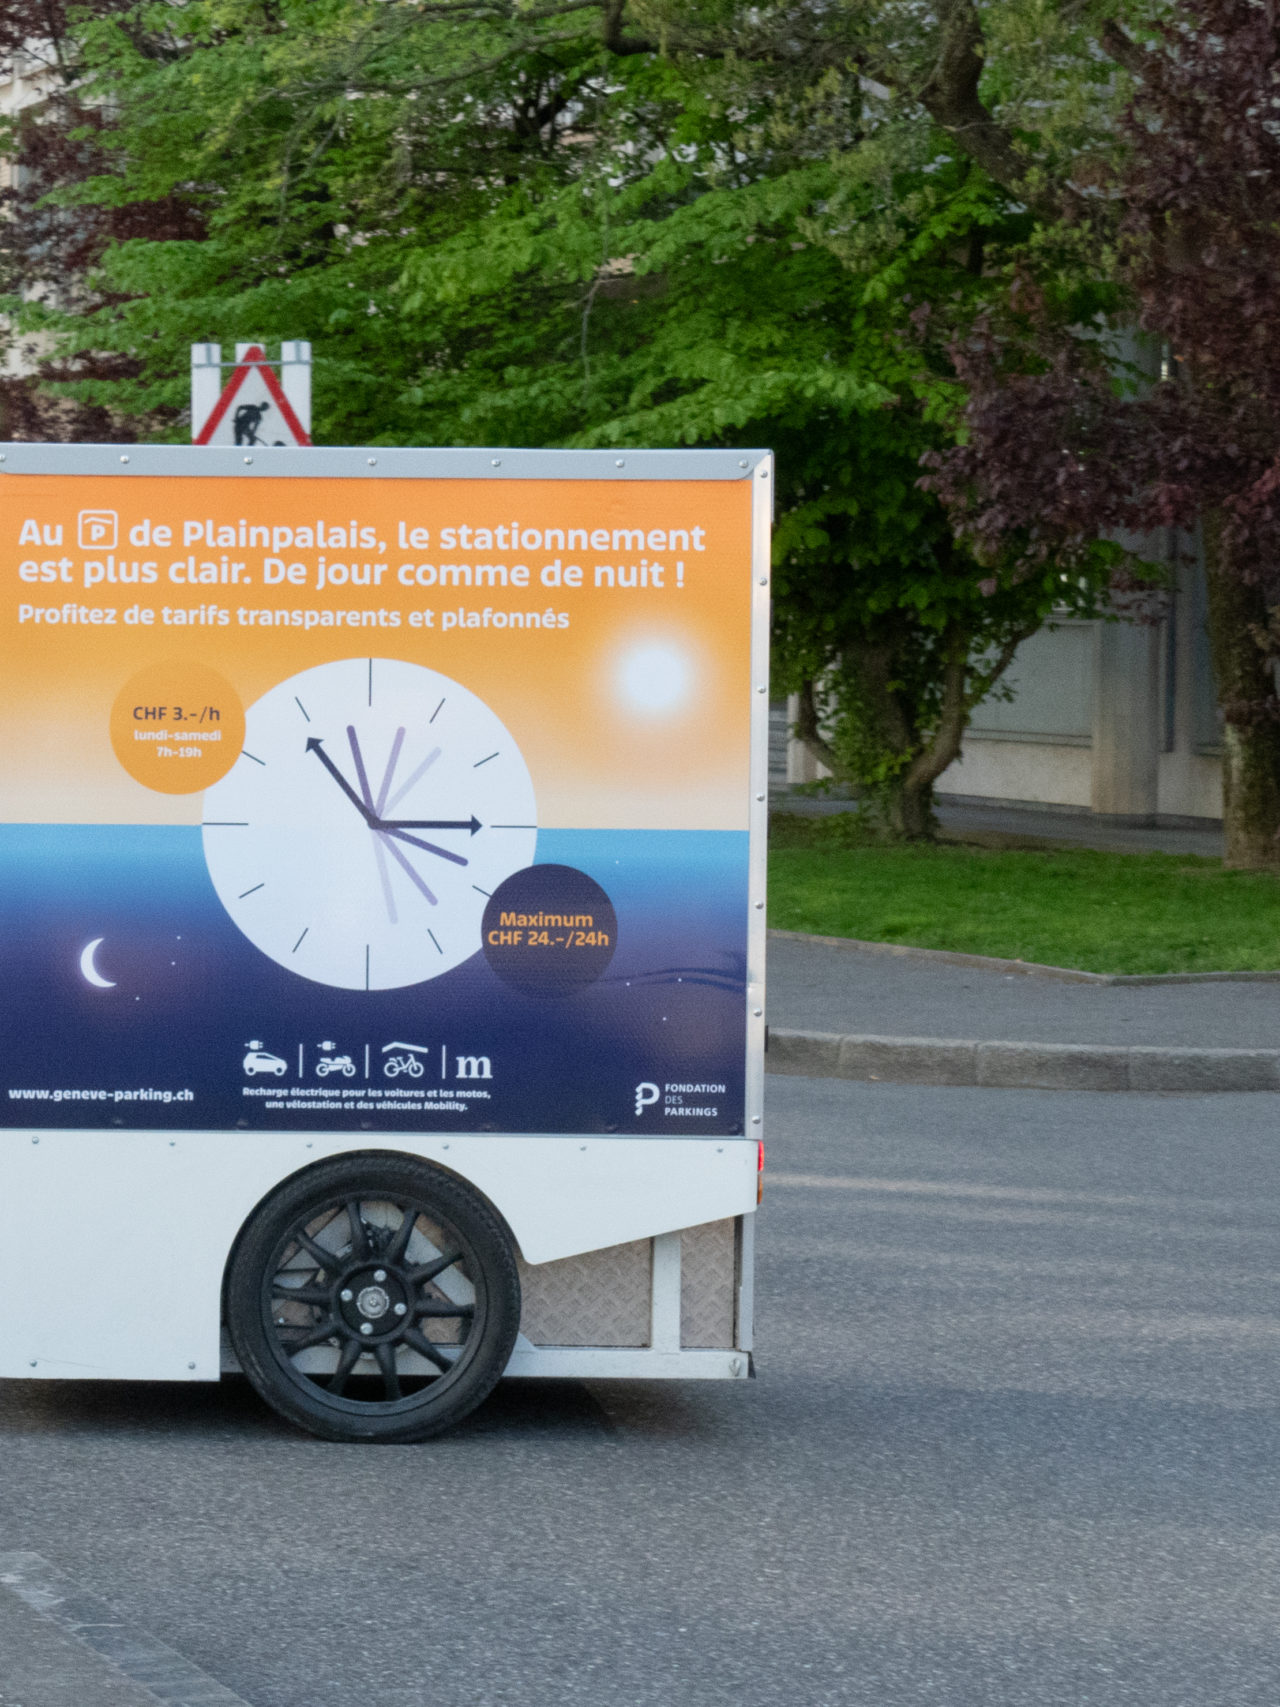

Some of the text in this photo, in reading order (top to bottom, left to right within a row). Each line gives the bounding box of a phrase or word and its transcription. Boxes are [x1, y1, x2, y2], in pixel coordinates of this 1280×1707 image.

[18, 518, 64, 547] Au
[128, 518, 173, 548] de
[183, 518, 387, 554] Plainpalais,
[398, 520, 430, 550] le
[439, 521, 706, 552] stationnement
[18, 554, 685, 591] est plus clair. De jour comme de nuit !
[18, 603, 570, 632] Profitez de tarifs transparents et plafonnés
[132, 705, 221, 724] CHF 3.-/h
[133, 729, 222, 742] lundi-samedi
[156, 745, 203, 758] 7h-19h
[499, 911, 594, 928] Maximum
[488, 930, 610, 948] CHF 24.-/24h
[456, 1055, 493, 1079] m
[8, 1087, 194, 1103] www.geneve-parking.ch
[242, 1087, 491, 1100] Recharge électrique pour les voitures et les motos,
[664, 1083, 726, 1094] FONDATION
[265, 1100, 468, 1112] une vélostation et des véhicules Mobility.
[664, 1095, 683, 1105] DES
[664, 1107, 718, 1117] PARKINGS
